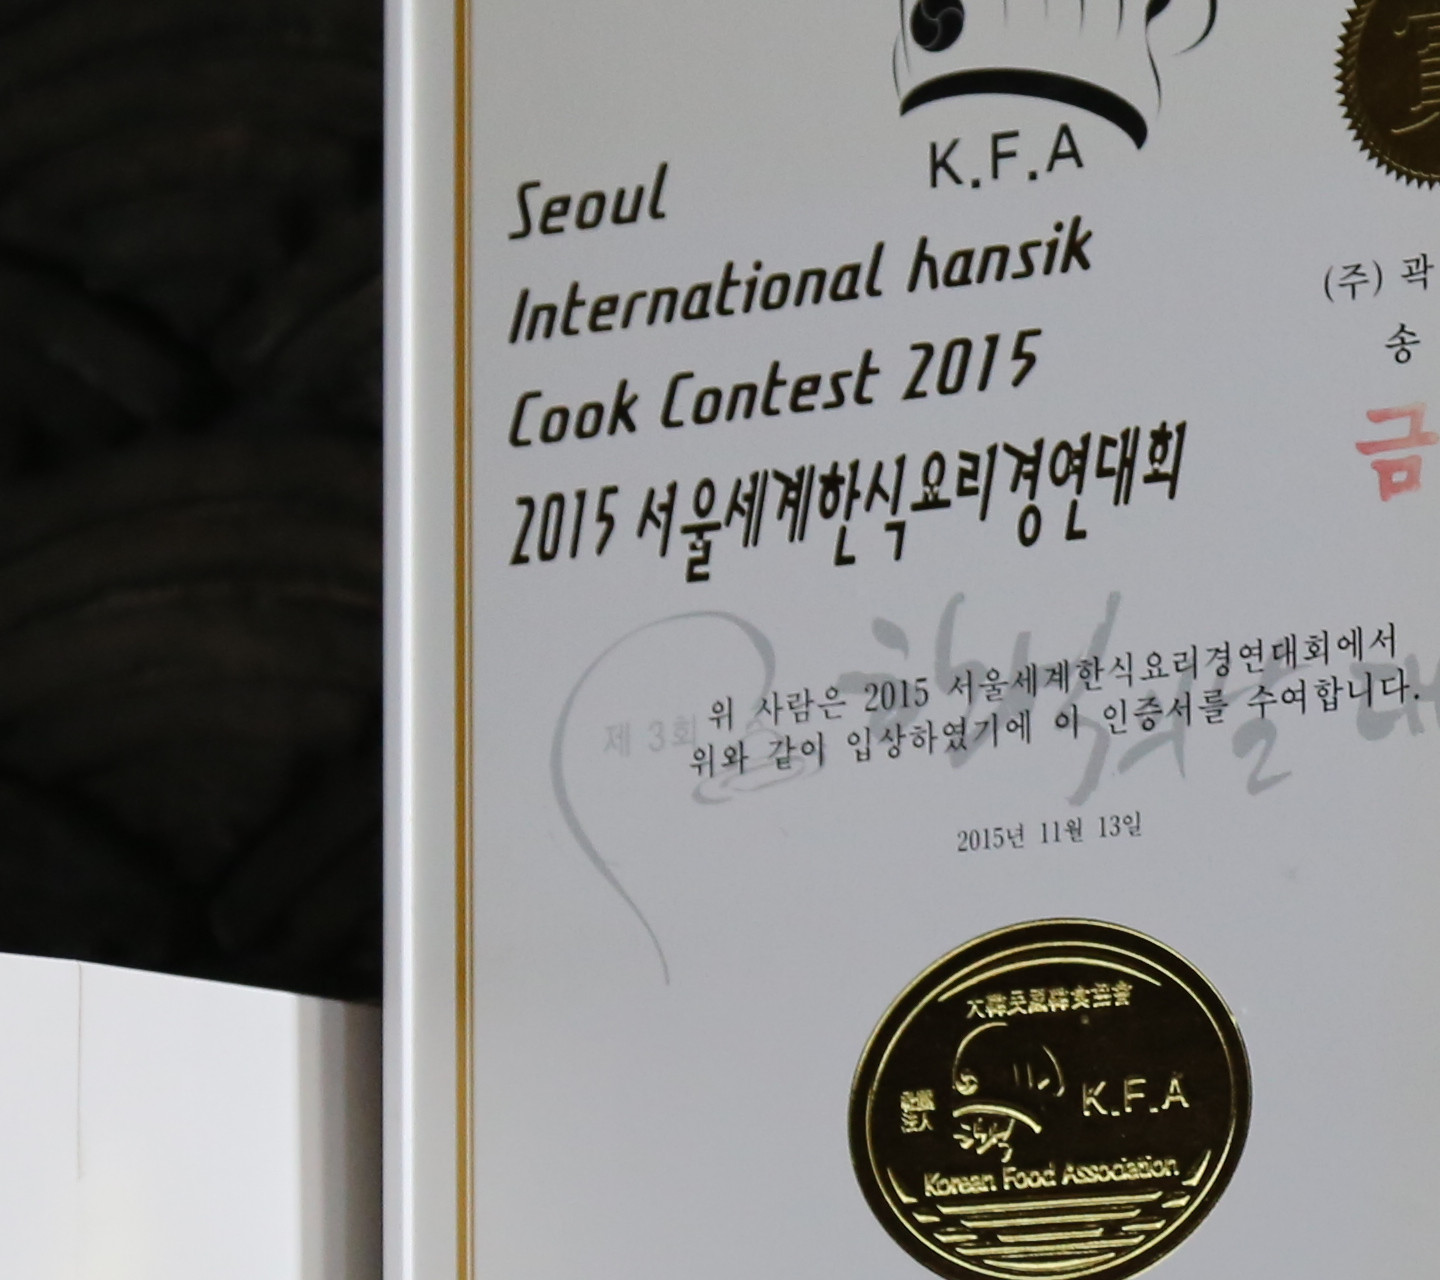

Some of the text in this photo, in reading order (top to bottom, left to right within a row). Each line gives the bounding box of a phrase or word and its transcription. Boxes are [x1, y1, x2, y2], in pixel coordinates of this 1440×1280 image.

[929, 122, 1085, 190] K.F.A
[507, 161, 669, 241] Seoul
[508, 214, 1094, 346] International hansik
[1323, 260, 1383, 303] (주)
[508, 327, 1043, 449] Cook Contest 2015
[508, 419, 1188, 584] 2015 서울세계한식요리경연대회
[708, 622, 1399, 732] 위 사람은 2015 서울세계한식요리경연대회에서
[689, 662, 1421, 779] 위와 같이 입상하였기에 이 인증서를 수여합니다.
[957, 810, 1142, 853] 2015년 11월 13일
[1077, 1075, 1191, 1117] K.F.A
[923, 1155, 1180, 1197] Korean Food Association
